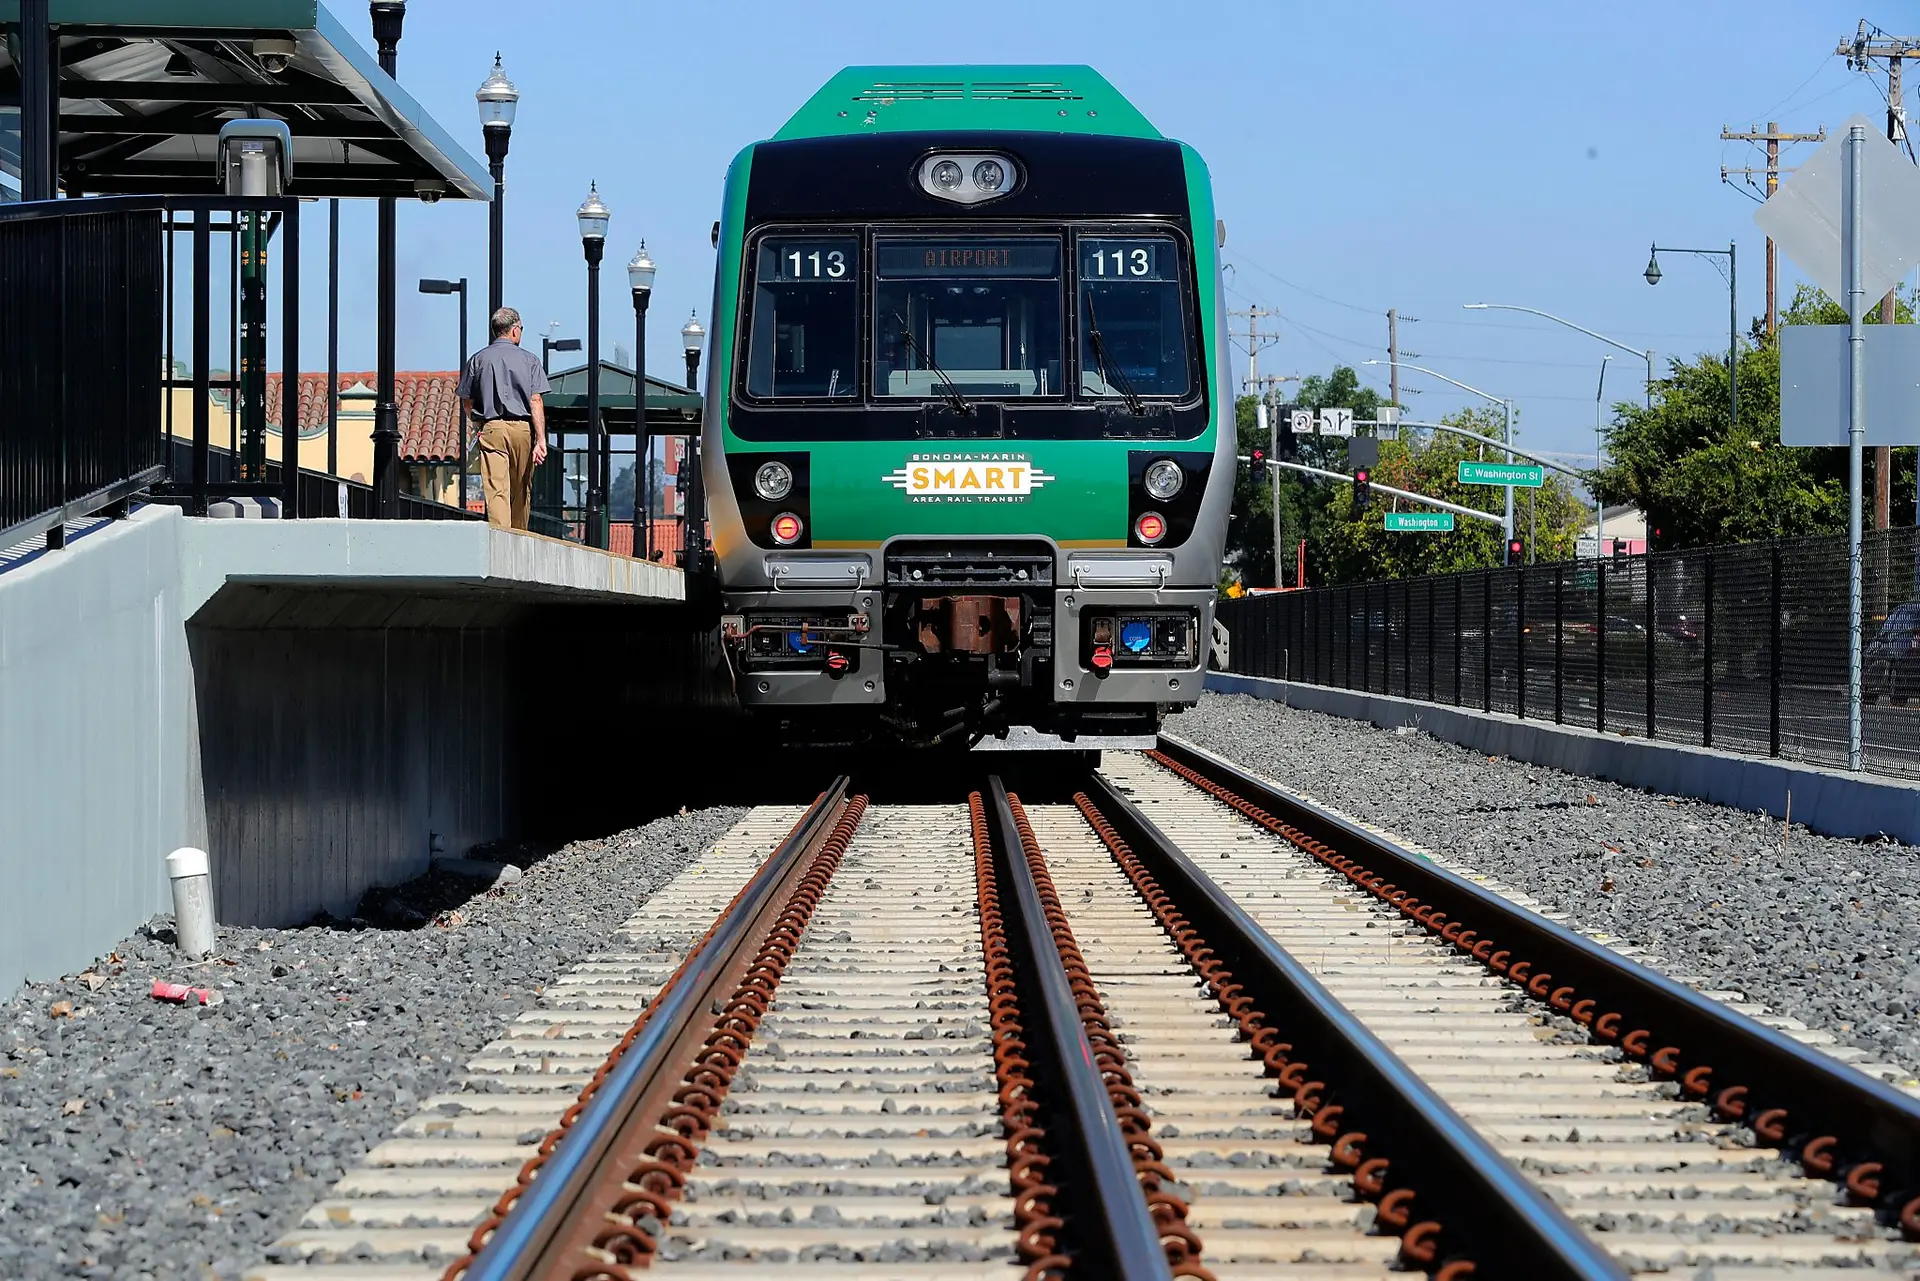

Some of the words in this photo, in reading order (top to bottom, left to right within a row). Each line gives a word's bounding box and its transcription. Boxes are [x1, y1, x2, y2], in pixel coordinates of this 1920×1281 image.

[789, 251, 845, 277] 113
[925, 249, 1010, 266] AIRPORT
[1092, 249, 1148, 275] 113
[912, 453, 1026, 461] SONOMA-MARIN
[912, 467, 1025, 489] SMART
[1464, 468, 1473, 477] E.
[1475, 469, 1527, 481] Washington
[1529, 471, 1538, 481] St
[1398, 517, 1438, 529] Washington
